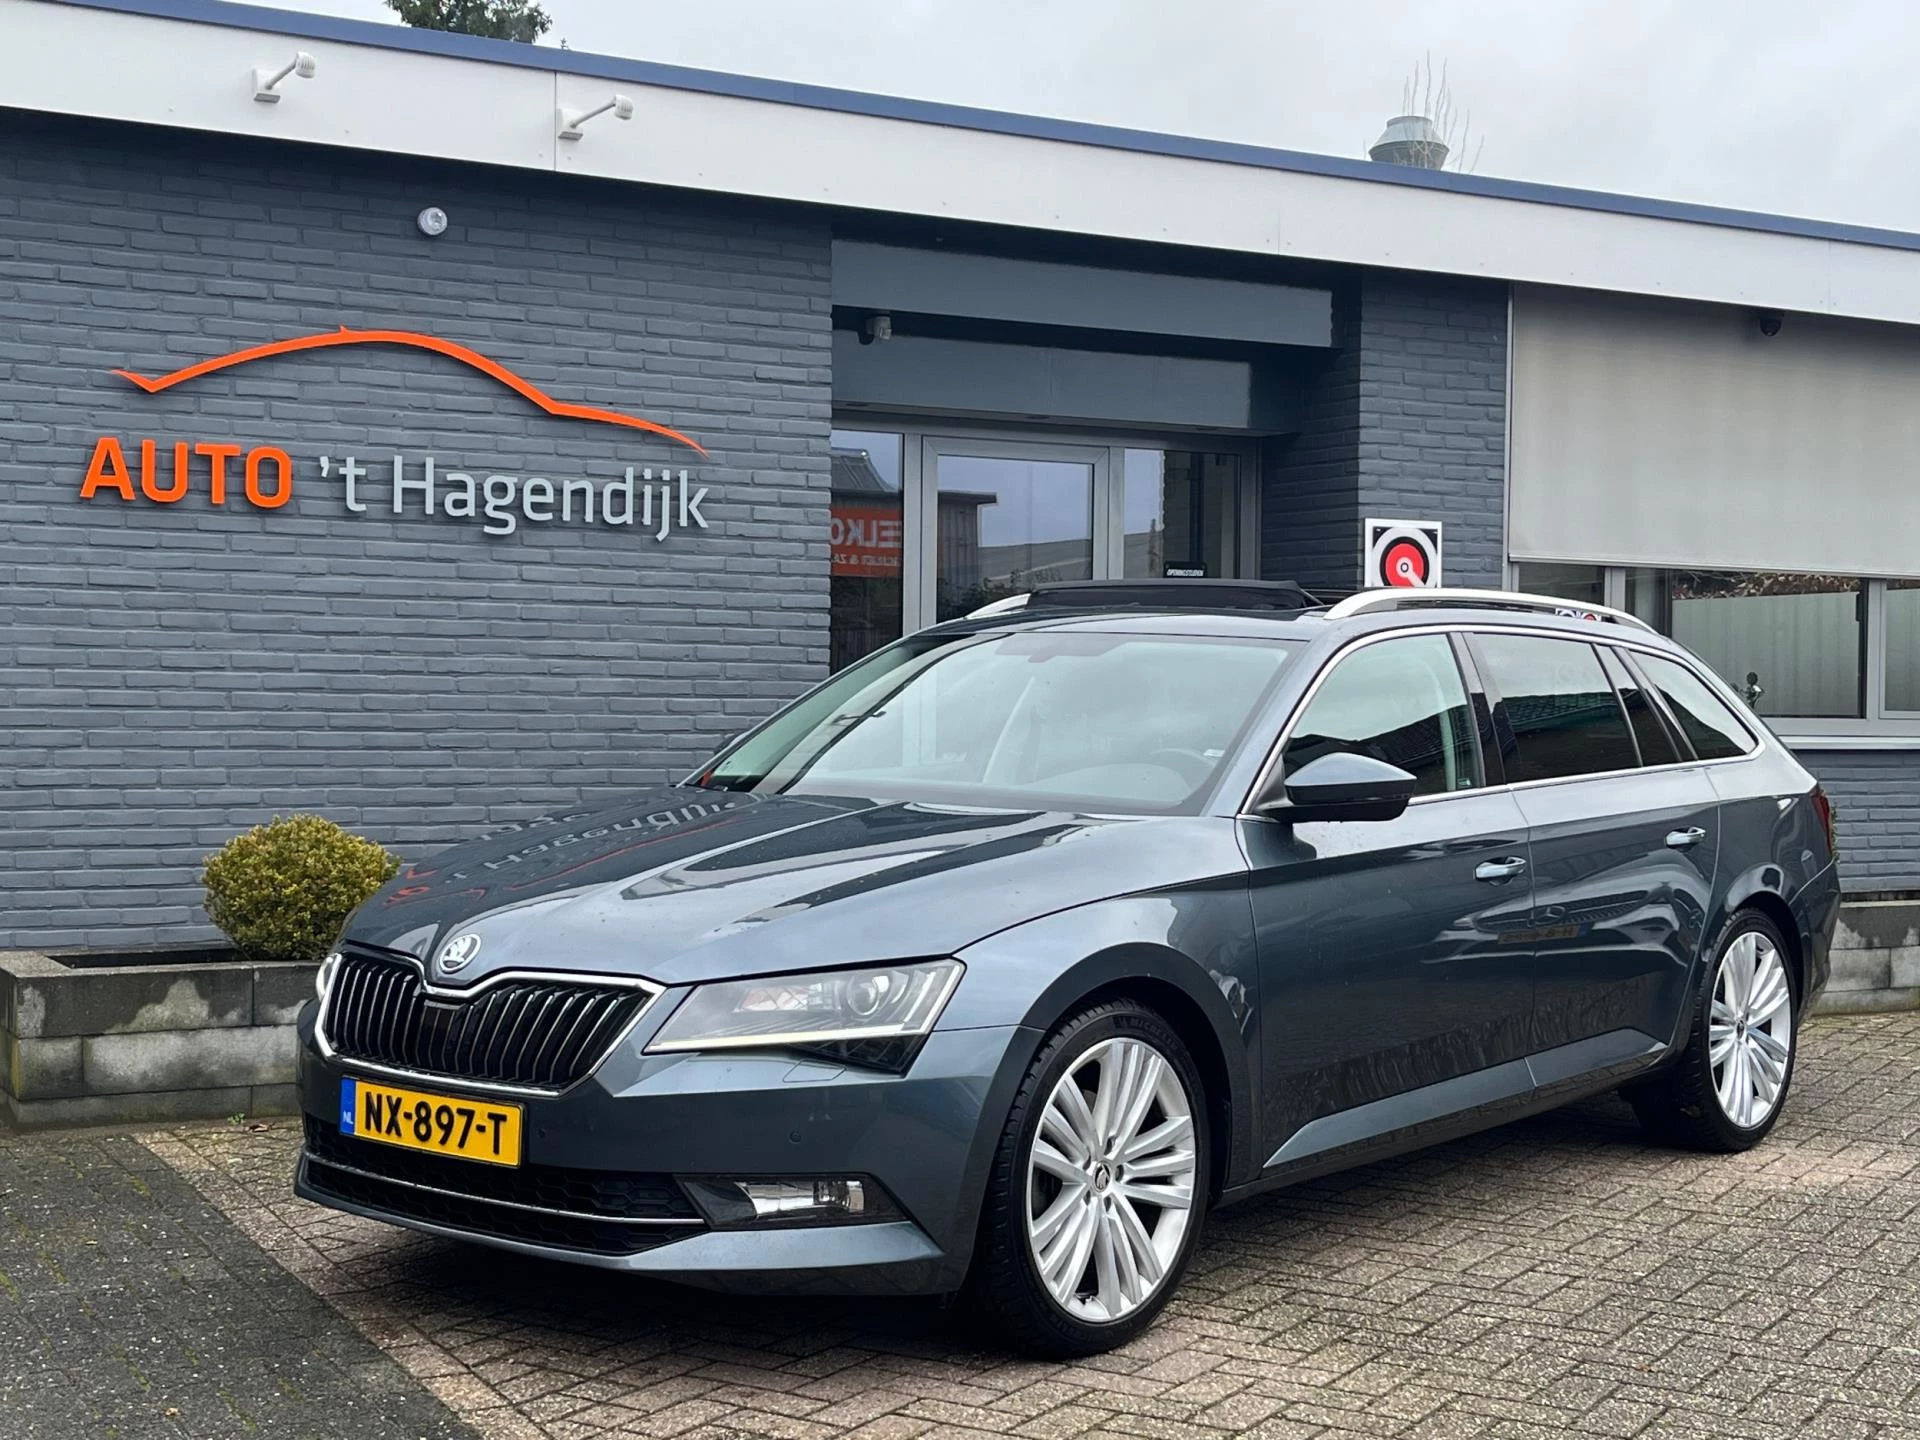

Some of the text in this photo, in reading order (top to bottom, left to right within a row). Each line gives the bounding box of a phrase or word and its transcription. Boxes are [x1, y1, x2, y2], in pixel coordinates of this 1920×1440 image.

[80, 437, 293, 509] AUTO
[393, 456, 710, 542] Hagendijk
[342, 1110, 354, 1125] NL
[365, 1091, 507, 1155] NX-897-T
